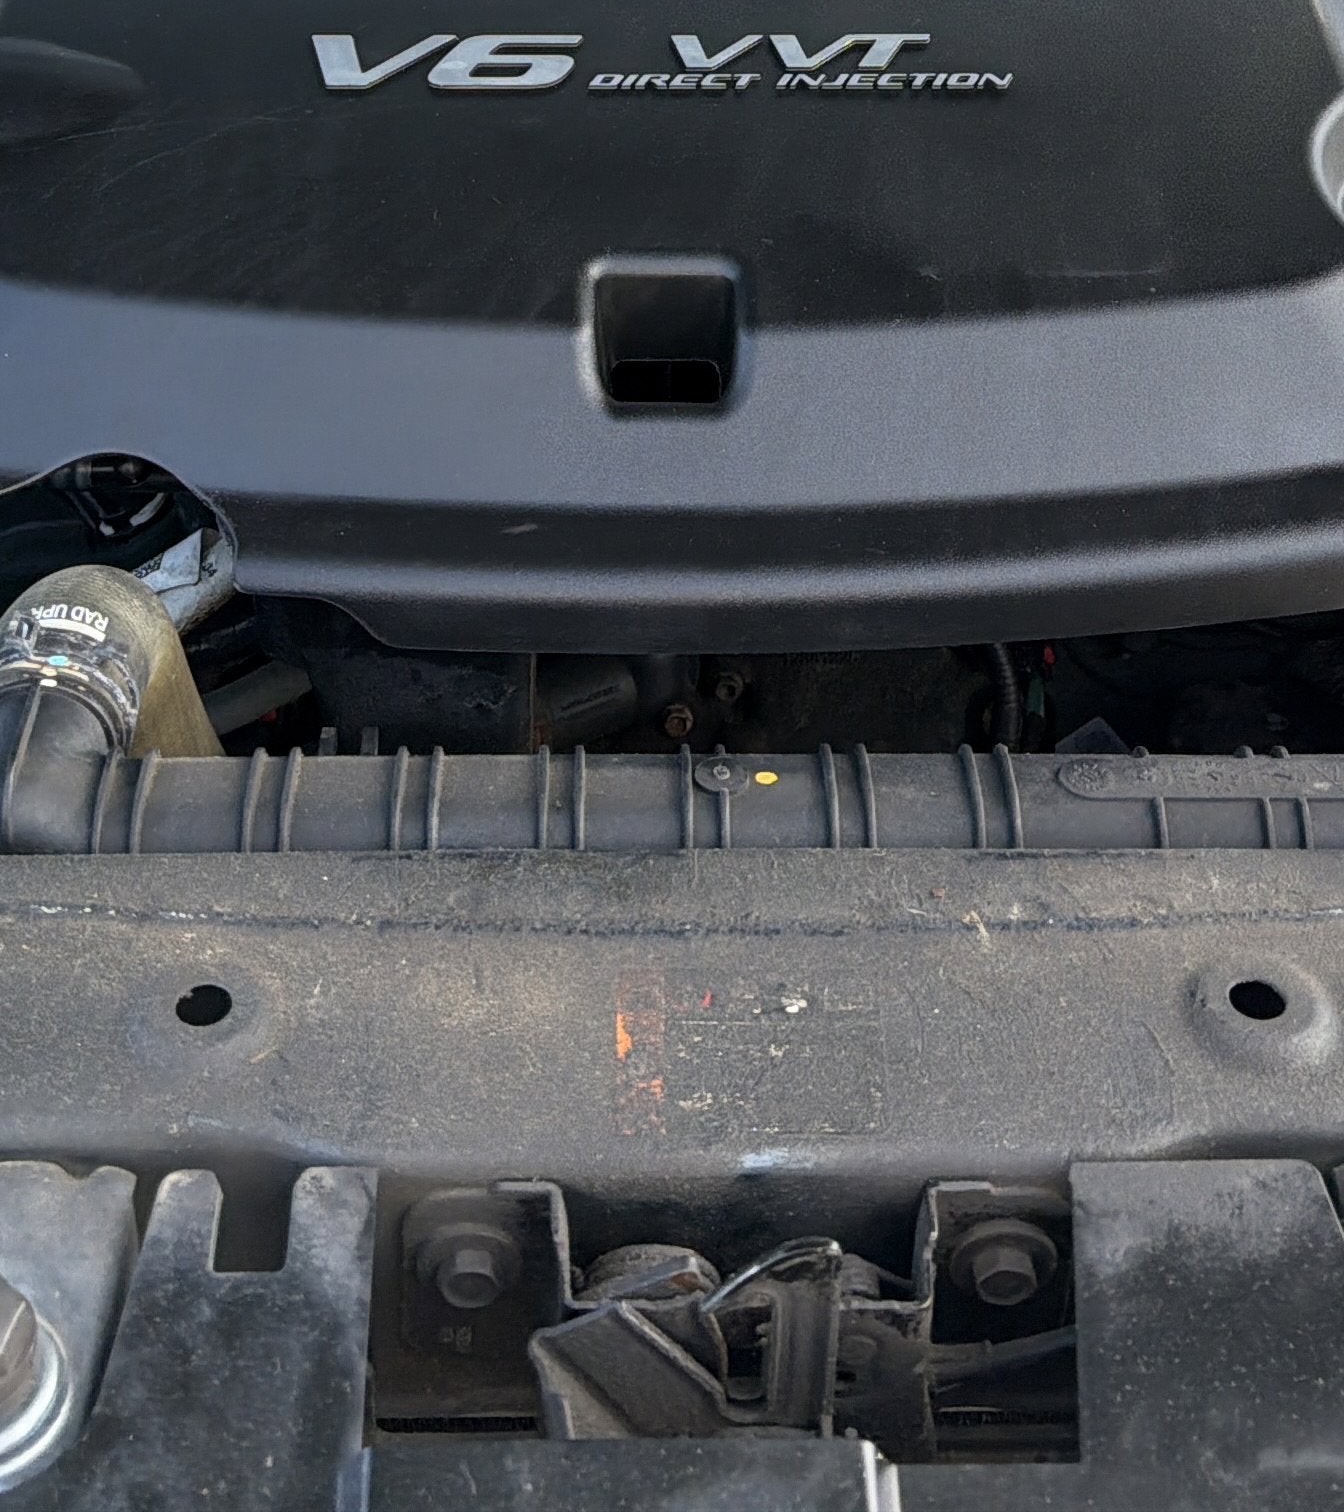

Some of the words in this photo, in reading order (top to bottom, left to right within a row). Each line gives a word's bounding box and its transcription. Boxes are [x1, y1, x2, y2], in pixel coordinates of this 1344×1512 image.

[310, 33, 584, 90] V6
[669, 32, 931, 72] VVT
[586, 72, 762, 92] DIRECT
[775, 72, 1015, 92] INJECTION
[70, 605, 109, 633] RAD
